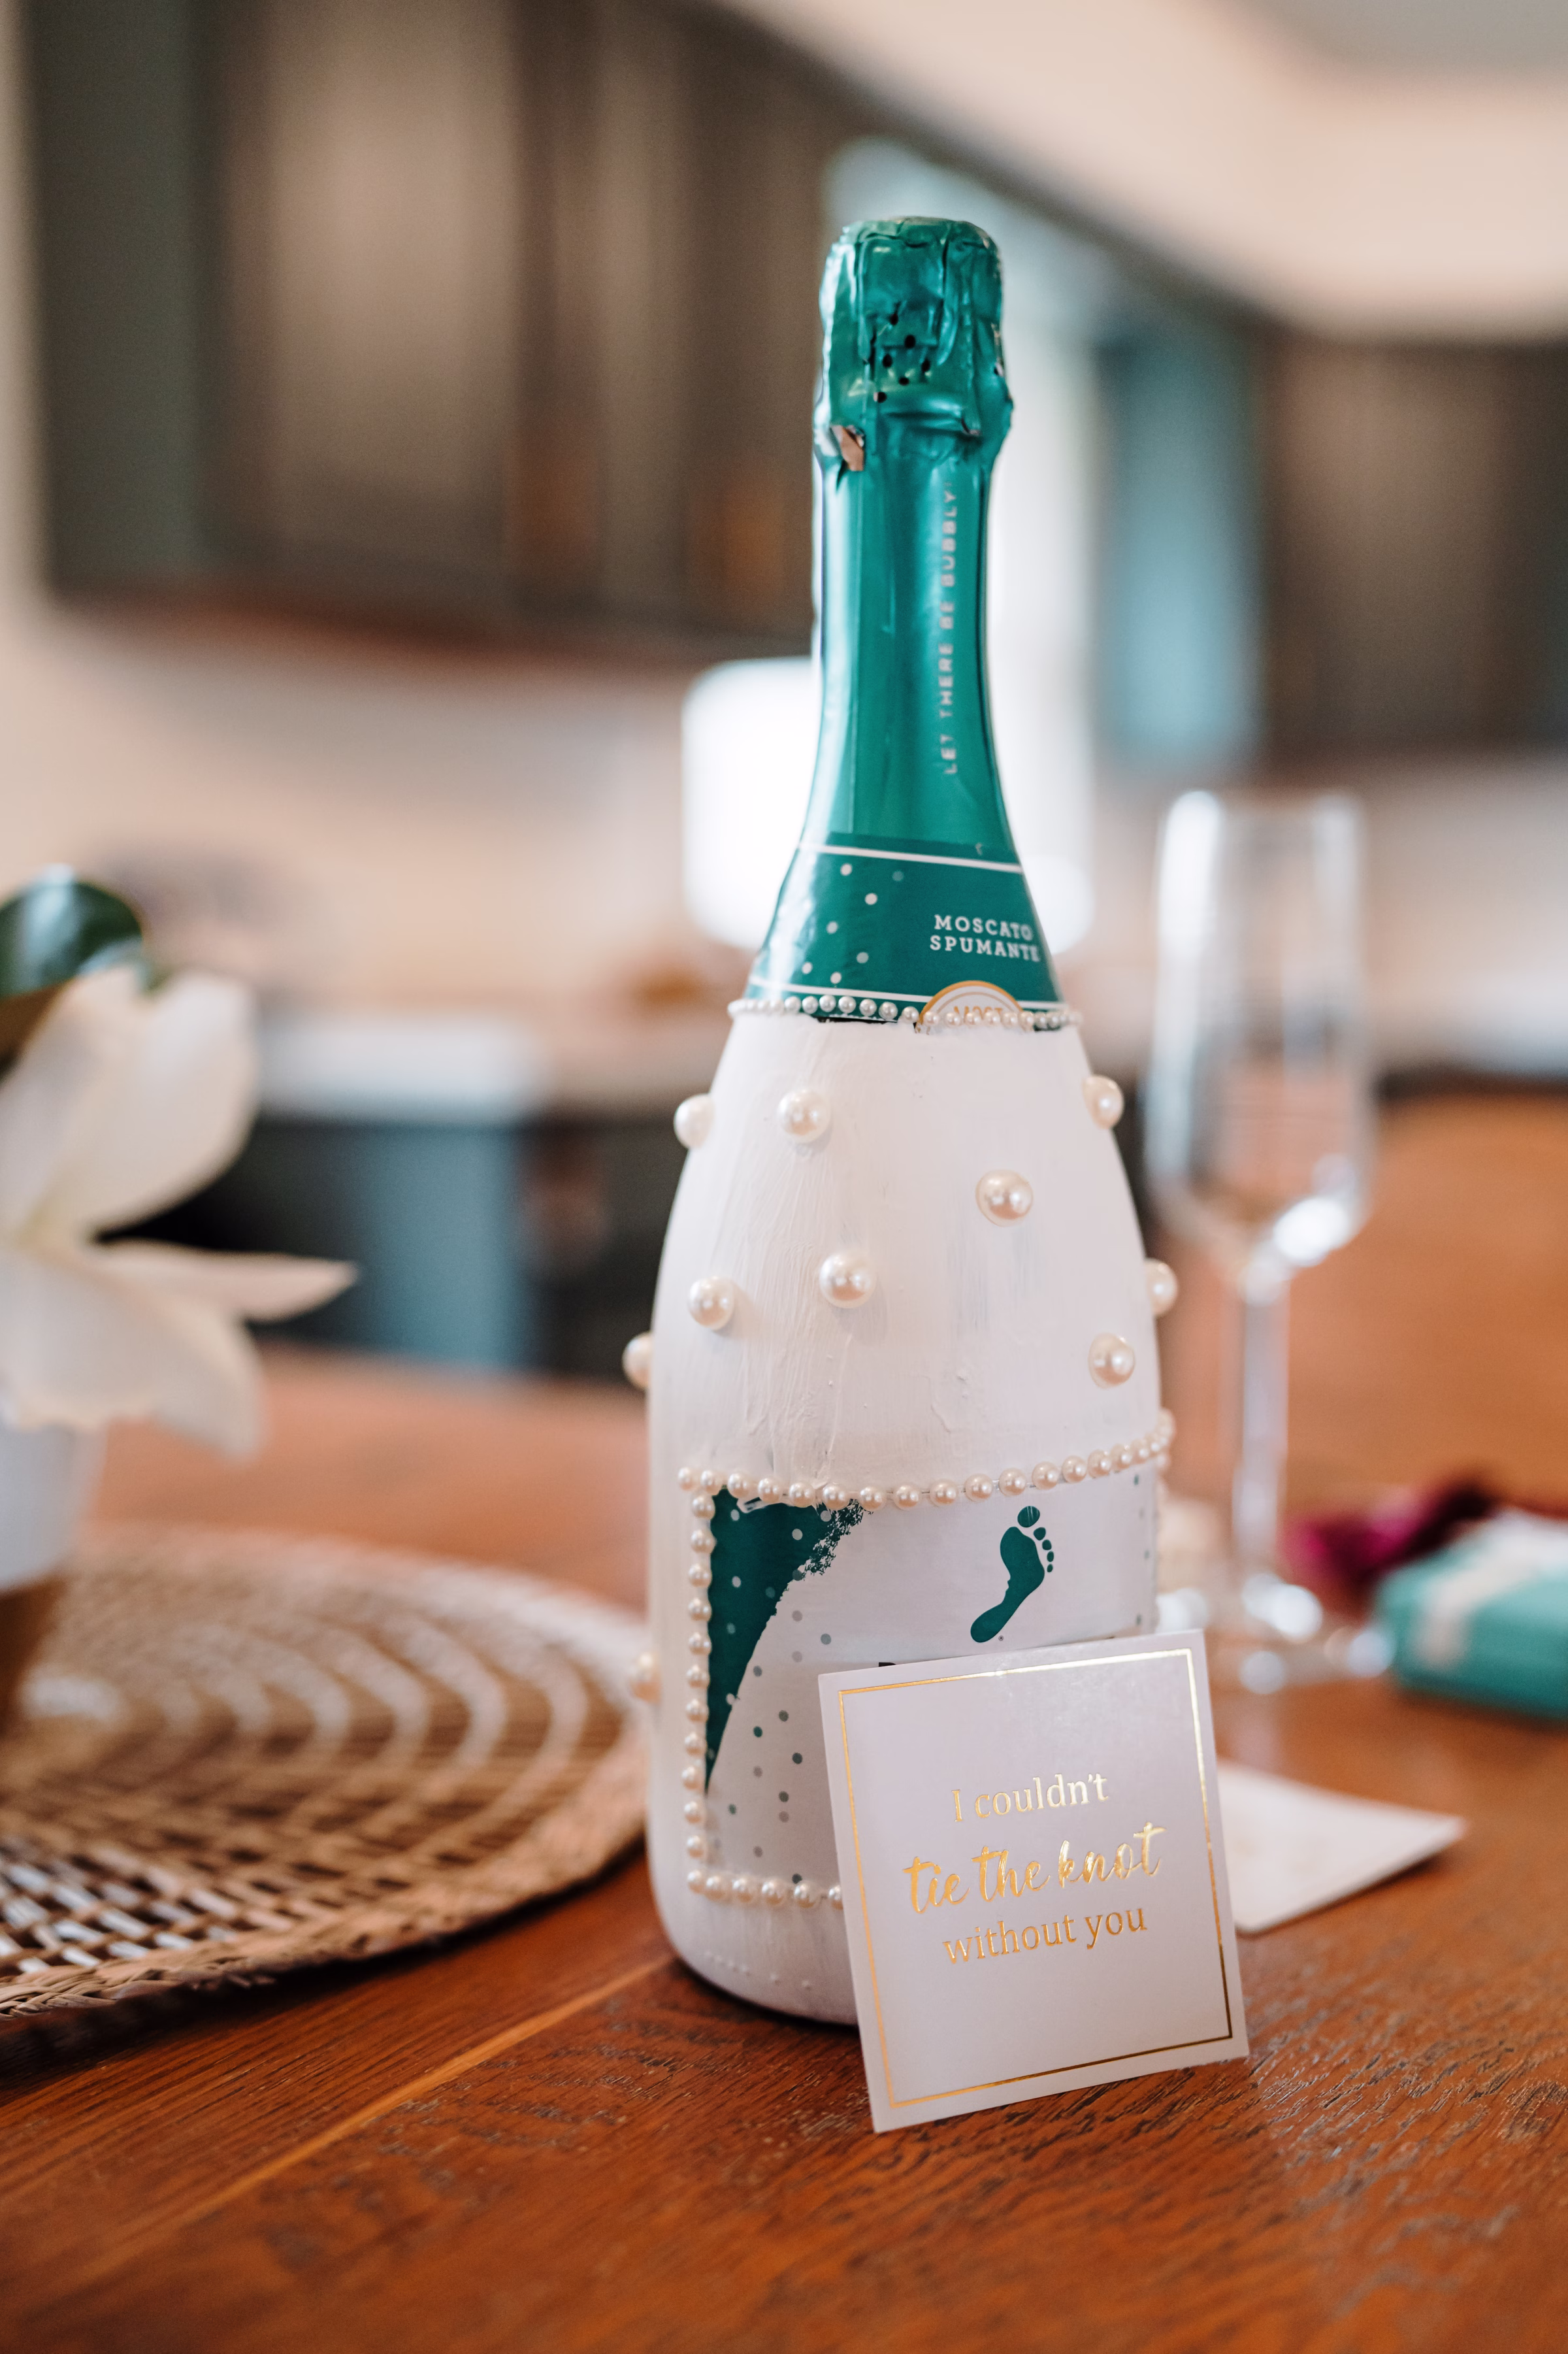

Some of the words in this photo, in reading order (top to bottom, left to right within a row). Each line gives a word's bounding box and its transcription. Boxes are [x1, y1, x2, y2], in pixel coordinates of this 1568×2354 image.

[940, 490, 957, 588] BUBBLY
[939, 601, 955, 630] BE
[938, 642, 954, 720] THERE
[939, 733, 958, 776] LET
[930, 935, 1041, 963] SPUMANTE
[934, 914, 1033, 941] MOSCATO
[951, 1789, 964, 1822] I
[974, 1773, 1109, 1819] couldn't
[903, 1856, 970, 1914] tie
[972, 1846, 1051, 1902] the
[1056, 1821, 1167, 1889] knot
[942, 1914, 1077, 1964] without
[1086, 1908, 1147, 1949] you
